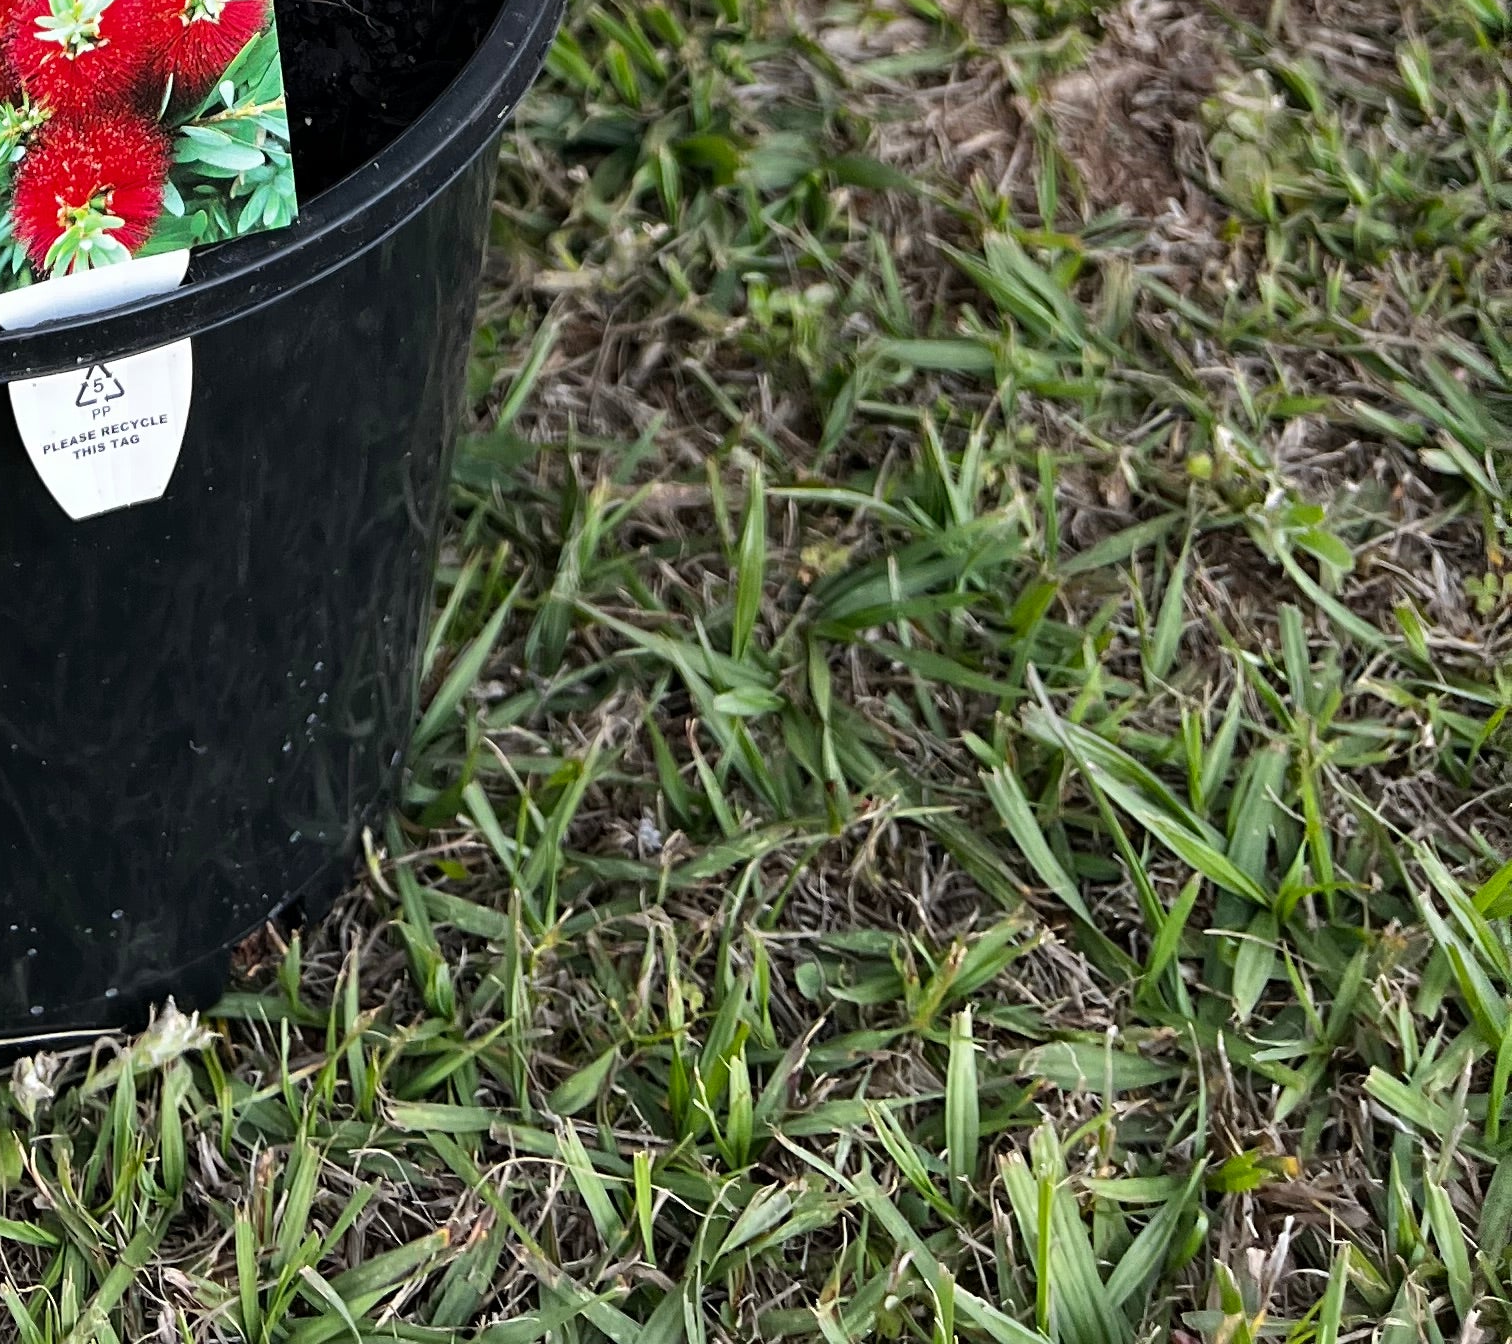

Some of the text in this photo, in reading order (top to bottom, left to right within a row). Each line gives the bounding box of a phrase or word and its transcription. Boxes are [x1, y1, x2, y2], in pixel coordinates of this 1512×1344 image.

[93, 378, 104, 393] 5
[92, 405, 112, 421] PP
[43, 413, 168, 455] PLEASE RECYCLE
[72, 434, 140, 460] THIS TAG
